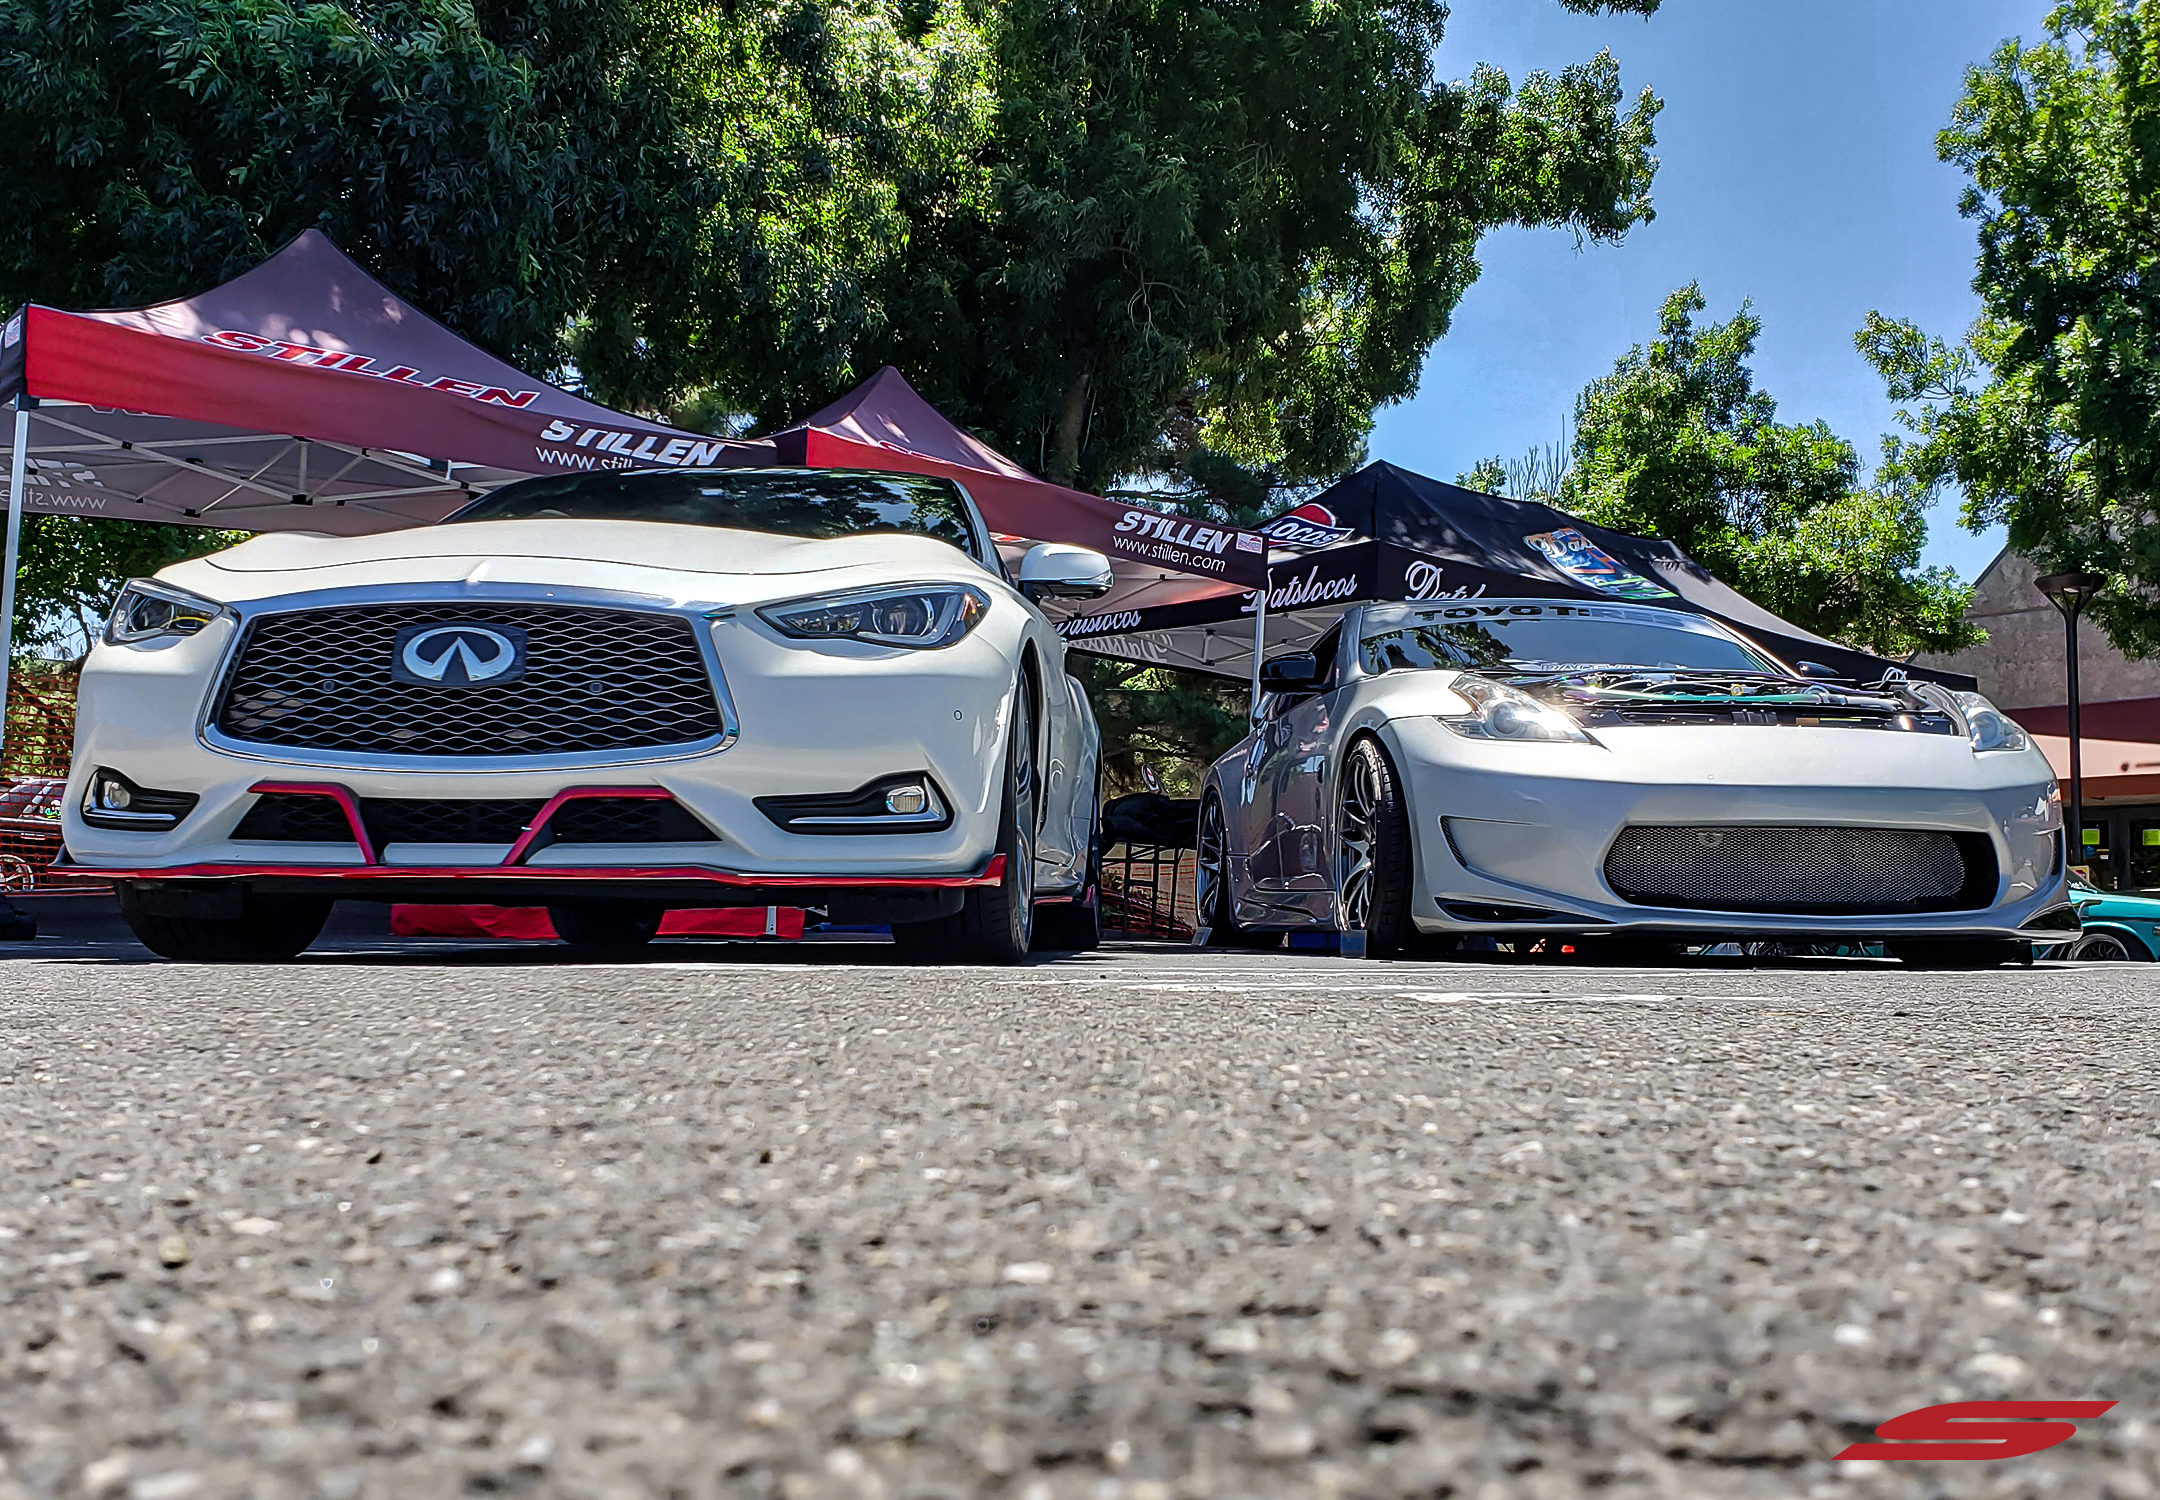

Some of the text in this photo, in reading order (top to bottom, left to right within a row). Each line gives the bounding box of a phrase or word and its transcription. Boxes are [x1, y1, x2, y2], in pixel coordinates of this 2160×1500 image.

[200, 331, 541, 408] STILLEN
[535, 446, 643, 470] www.still
[541, 420, 726, 466] STILLEN
[1114, 511, 1234, 554] STILLEN
[1112, 535, 1226, 573] www.stillen.com
[1414, 605, 1544, 622] TOYO
